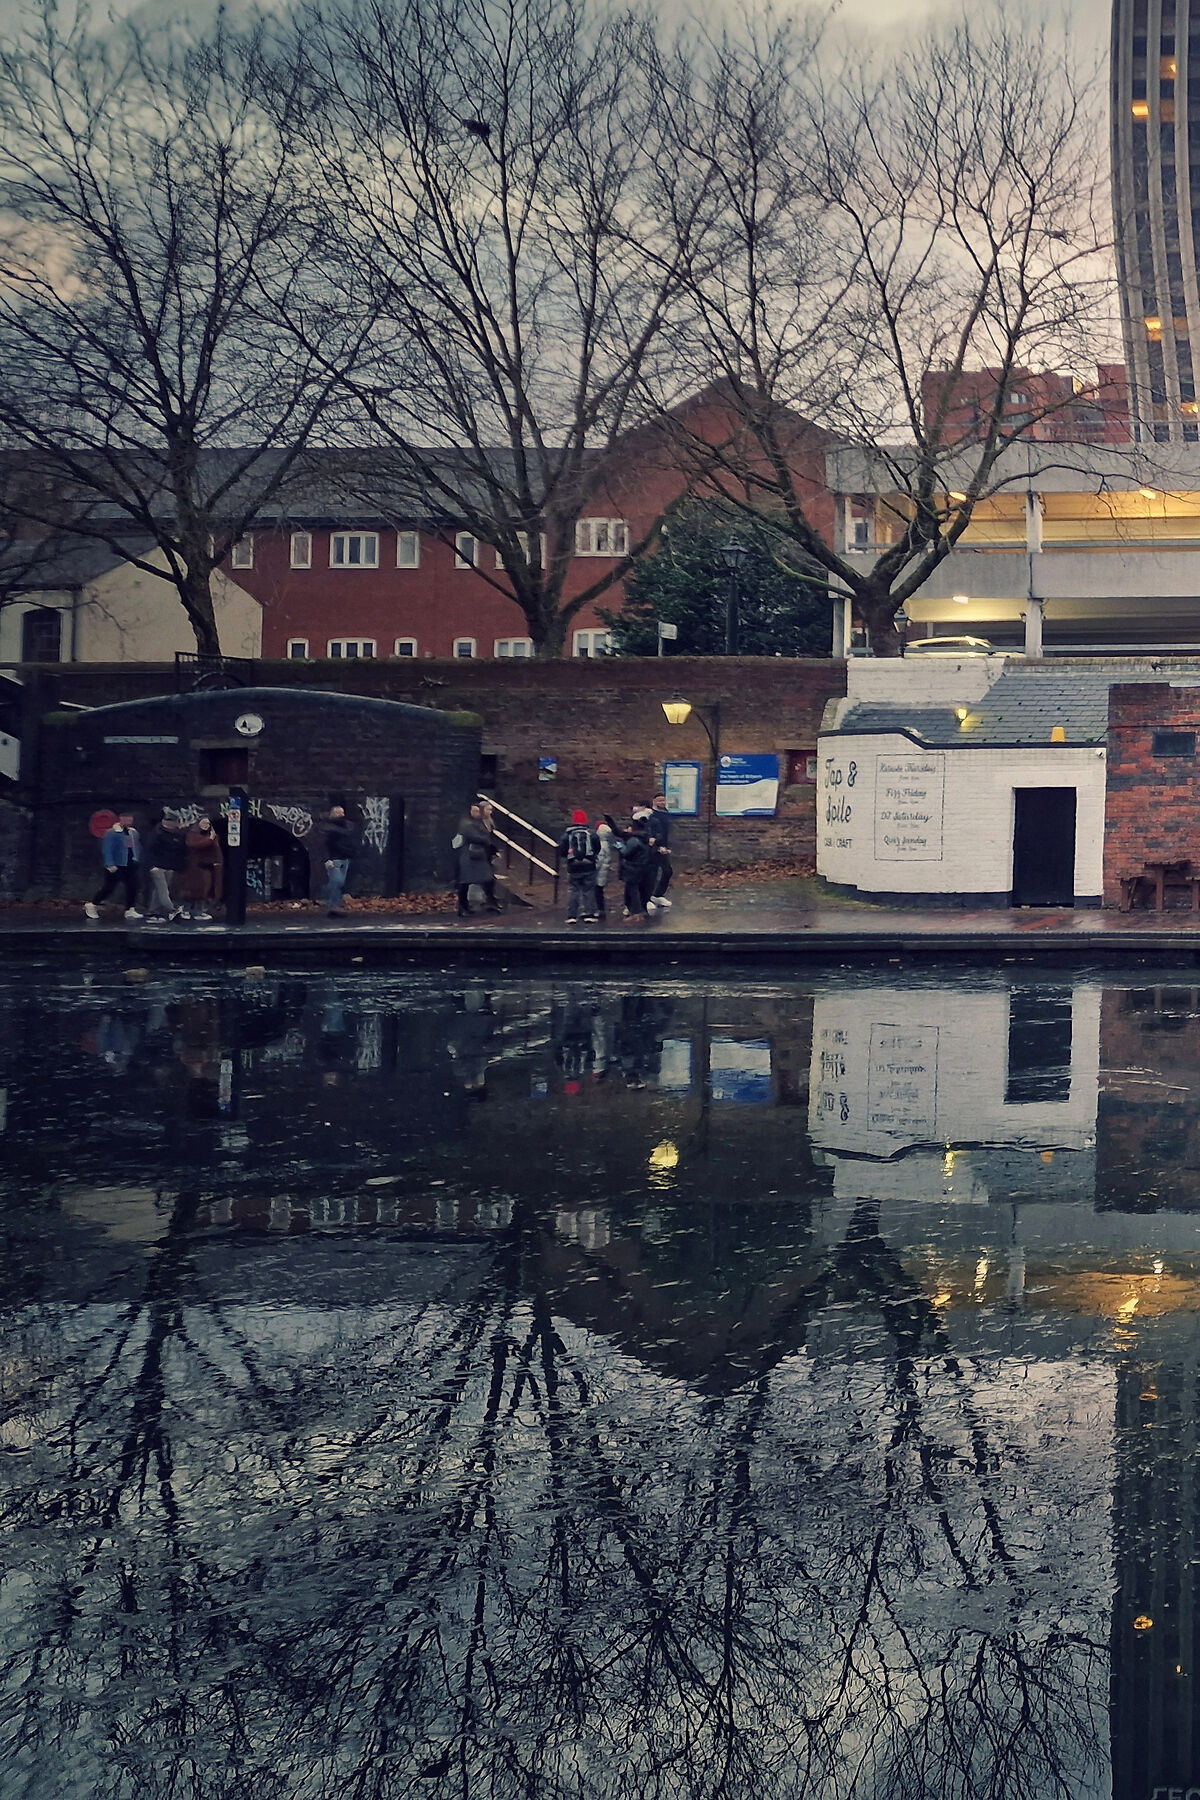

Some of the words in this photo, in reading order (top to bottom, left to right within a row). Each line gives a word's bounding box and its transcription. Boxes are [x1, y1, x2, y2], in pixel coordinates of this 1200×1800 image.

[825, 758, 842, 791] Tap
[847, 760, 858, 787] &
[826, 795, 852, 826] Spile
[893, 811, 933, 823] Saturday
